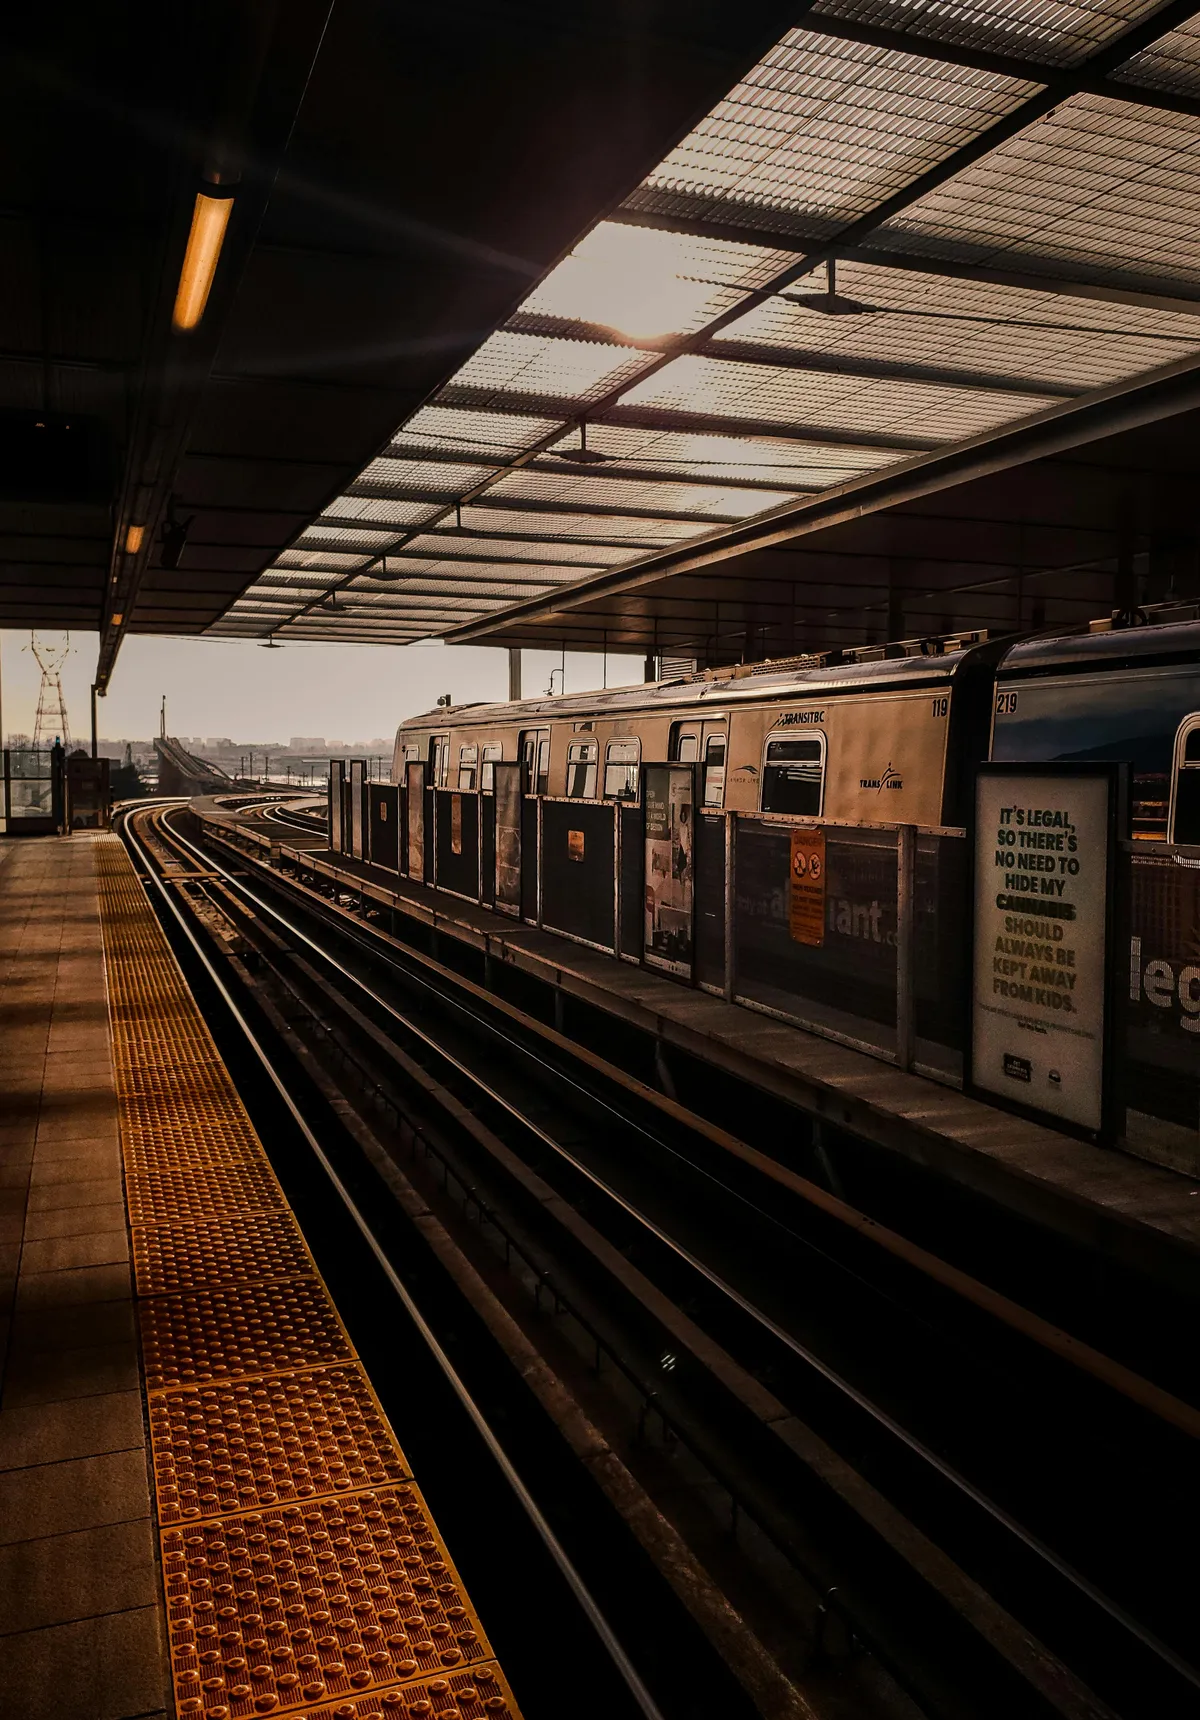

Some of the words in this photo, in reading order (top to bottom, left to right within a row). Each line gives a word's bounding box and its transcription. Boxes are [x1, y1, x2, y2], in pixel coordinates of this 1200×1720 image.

[932, 699, 948, 718] 119
[996, 693, 1017, 714] 219
[1000, 805, 1024, 825] IT'S
[1027, 809, 1075, 834] LEGAL,
[998, 829, 1016, 846] SO
[1018, 830, 1077, 852] THERE'S
[995, 850, 1015, 868] NO
[1018, 853, 1055, 873] NEED
[1058, 856, 1080, 875] TO
[1005, 873, 1038, 893] HIDE
[1040, 877, 1066, 896] MY
[1005, 916, 1064, 942] SHOULD
[994, 936, 1053, 963] ALWAYS
[1056, 948, 1076, 968] BE
[993, 956, 1028, 979] KEPT
[1029, 965, 1077, 990] AWAY
[1130, 935, 1200, 1033] leg
[993, 977, 1033, 1003] FROM
[1035, 987, 1078, 1014] KIDS.
